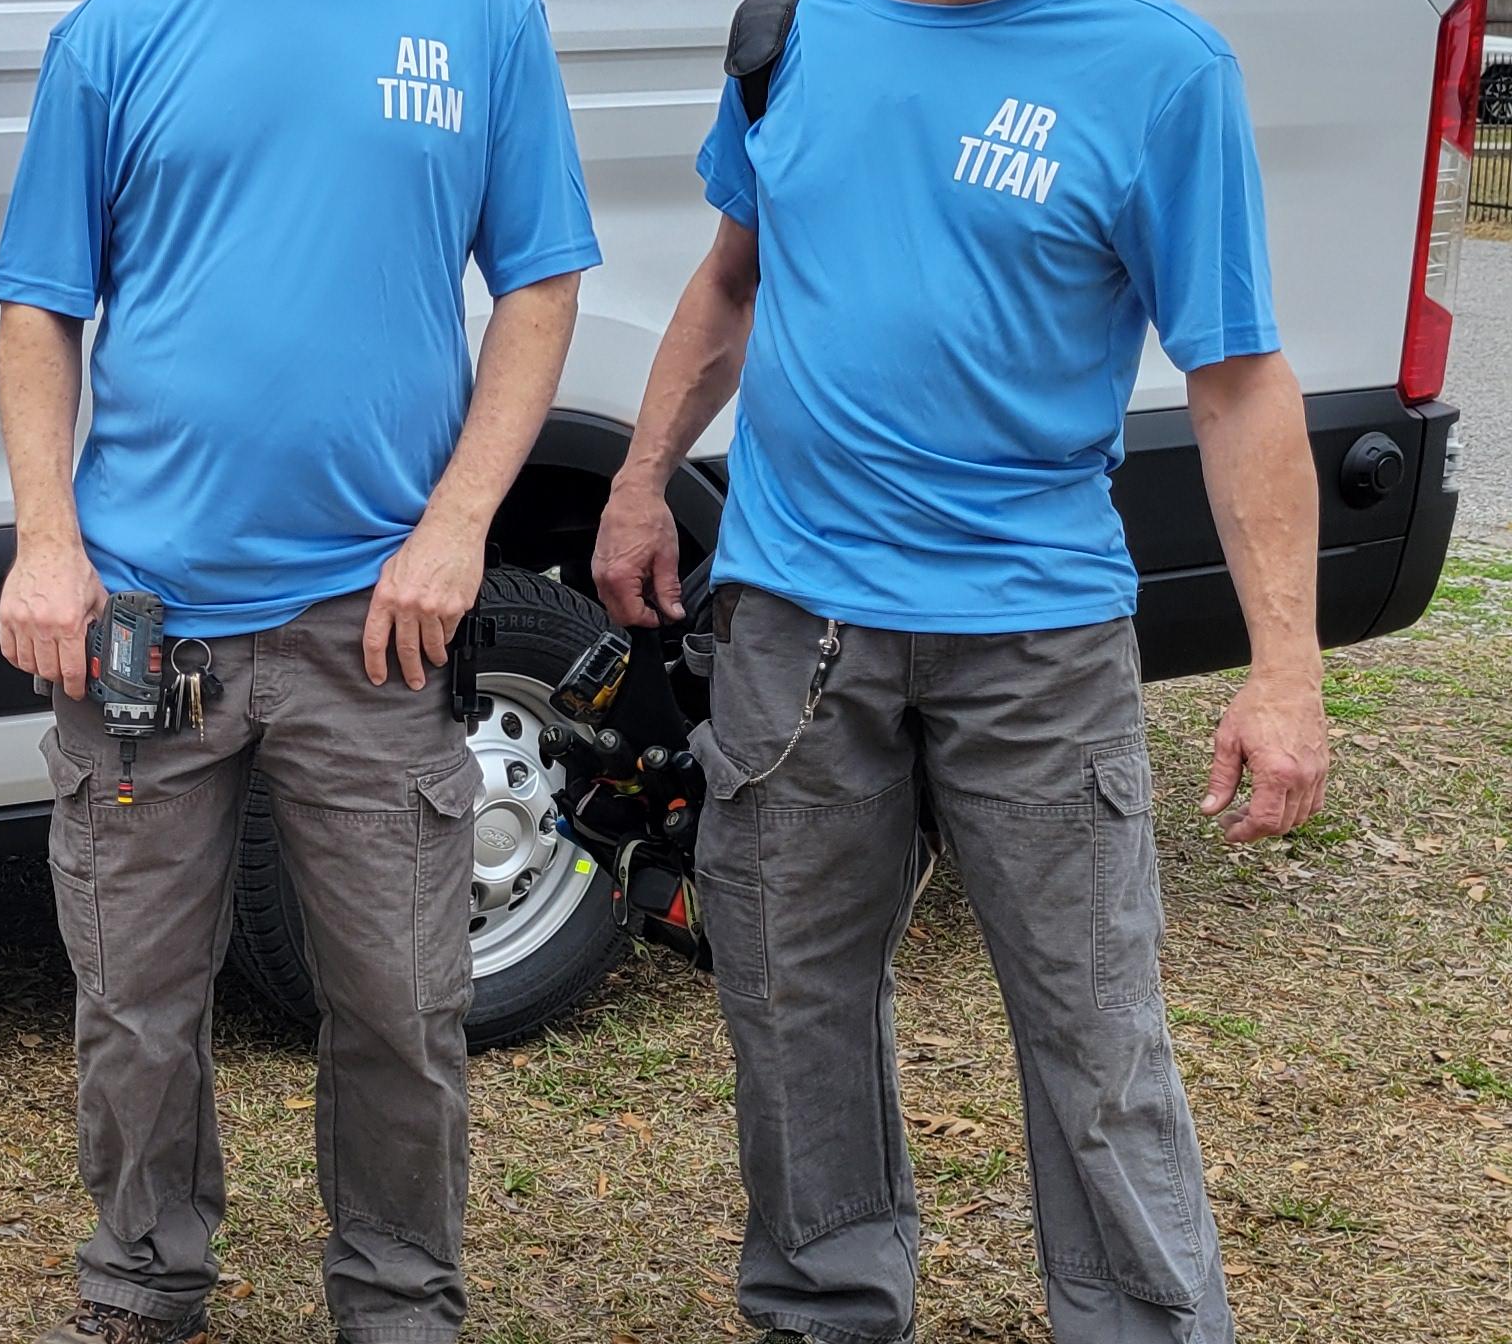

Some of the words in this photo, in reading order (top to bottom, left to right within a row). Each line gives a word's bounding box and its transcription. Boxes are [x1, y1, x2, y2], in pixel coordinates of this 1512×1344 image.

[396, 36, 450, 82] AIR
[376, 77, 464, 134] TITAN
[983, 97, 1057, 152] AIR
[953, 135, 1061, 205] TITAN
